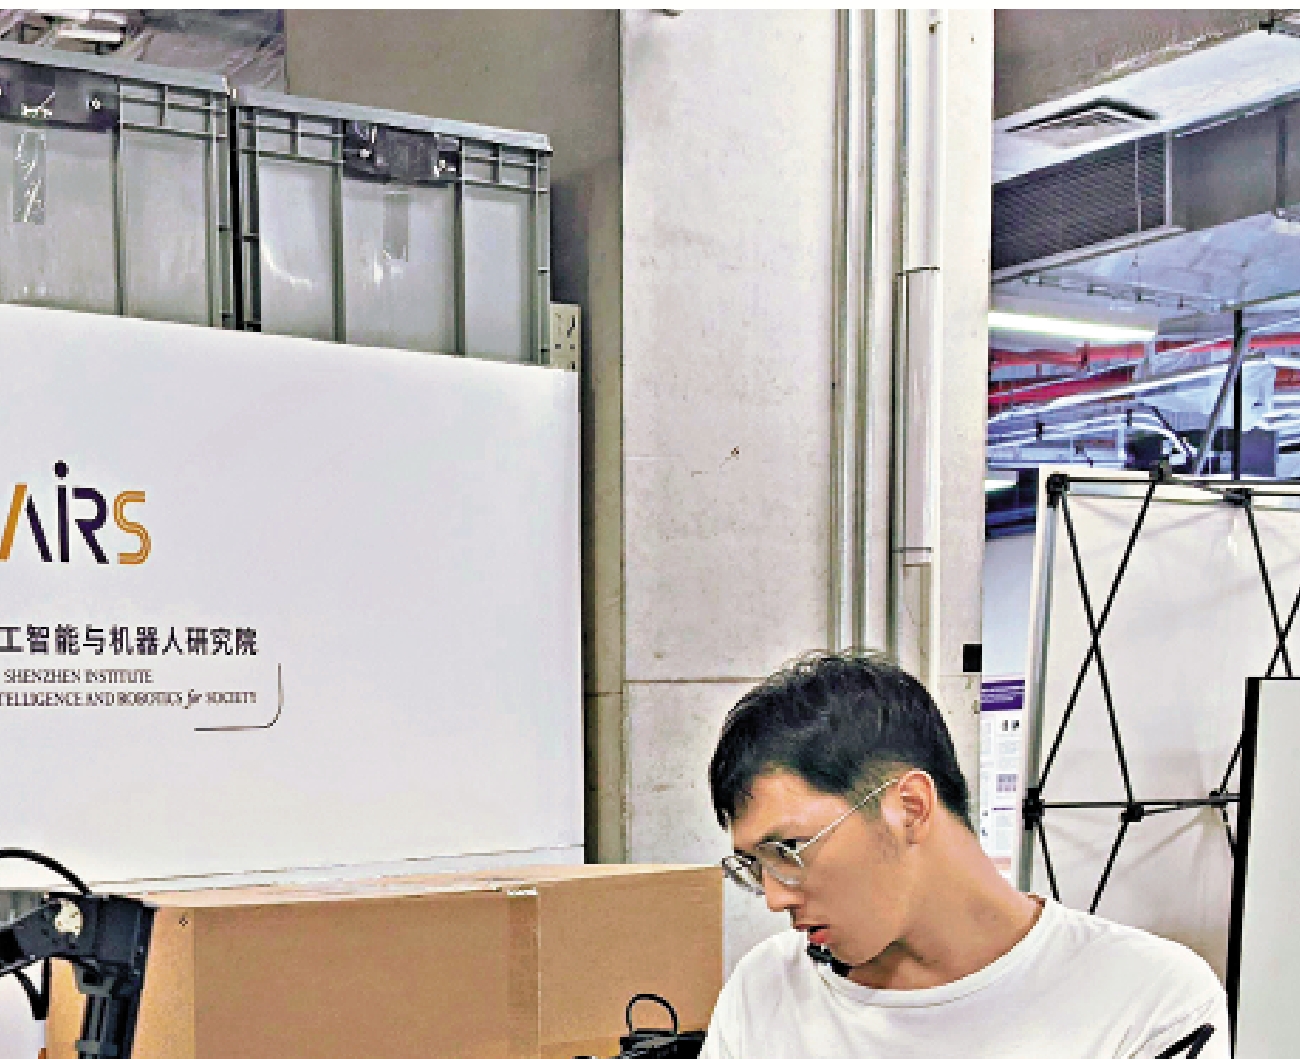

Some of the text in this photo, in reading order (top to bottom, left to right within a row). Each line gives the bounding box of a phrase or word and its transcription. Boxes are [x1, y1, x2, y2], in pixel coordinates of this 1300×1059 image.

[3, 668, 155, 684] SHENZHEN INSTITUTE
[85, 691, 115, 707] AND
[116, 691, 184, 707] ROBOTICS
[182, 688, 203, 710] for
[204, 691, 257, 704] SOCIETY
